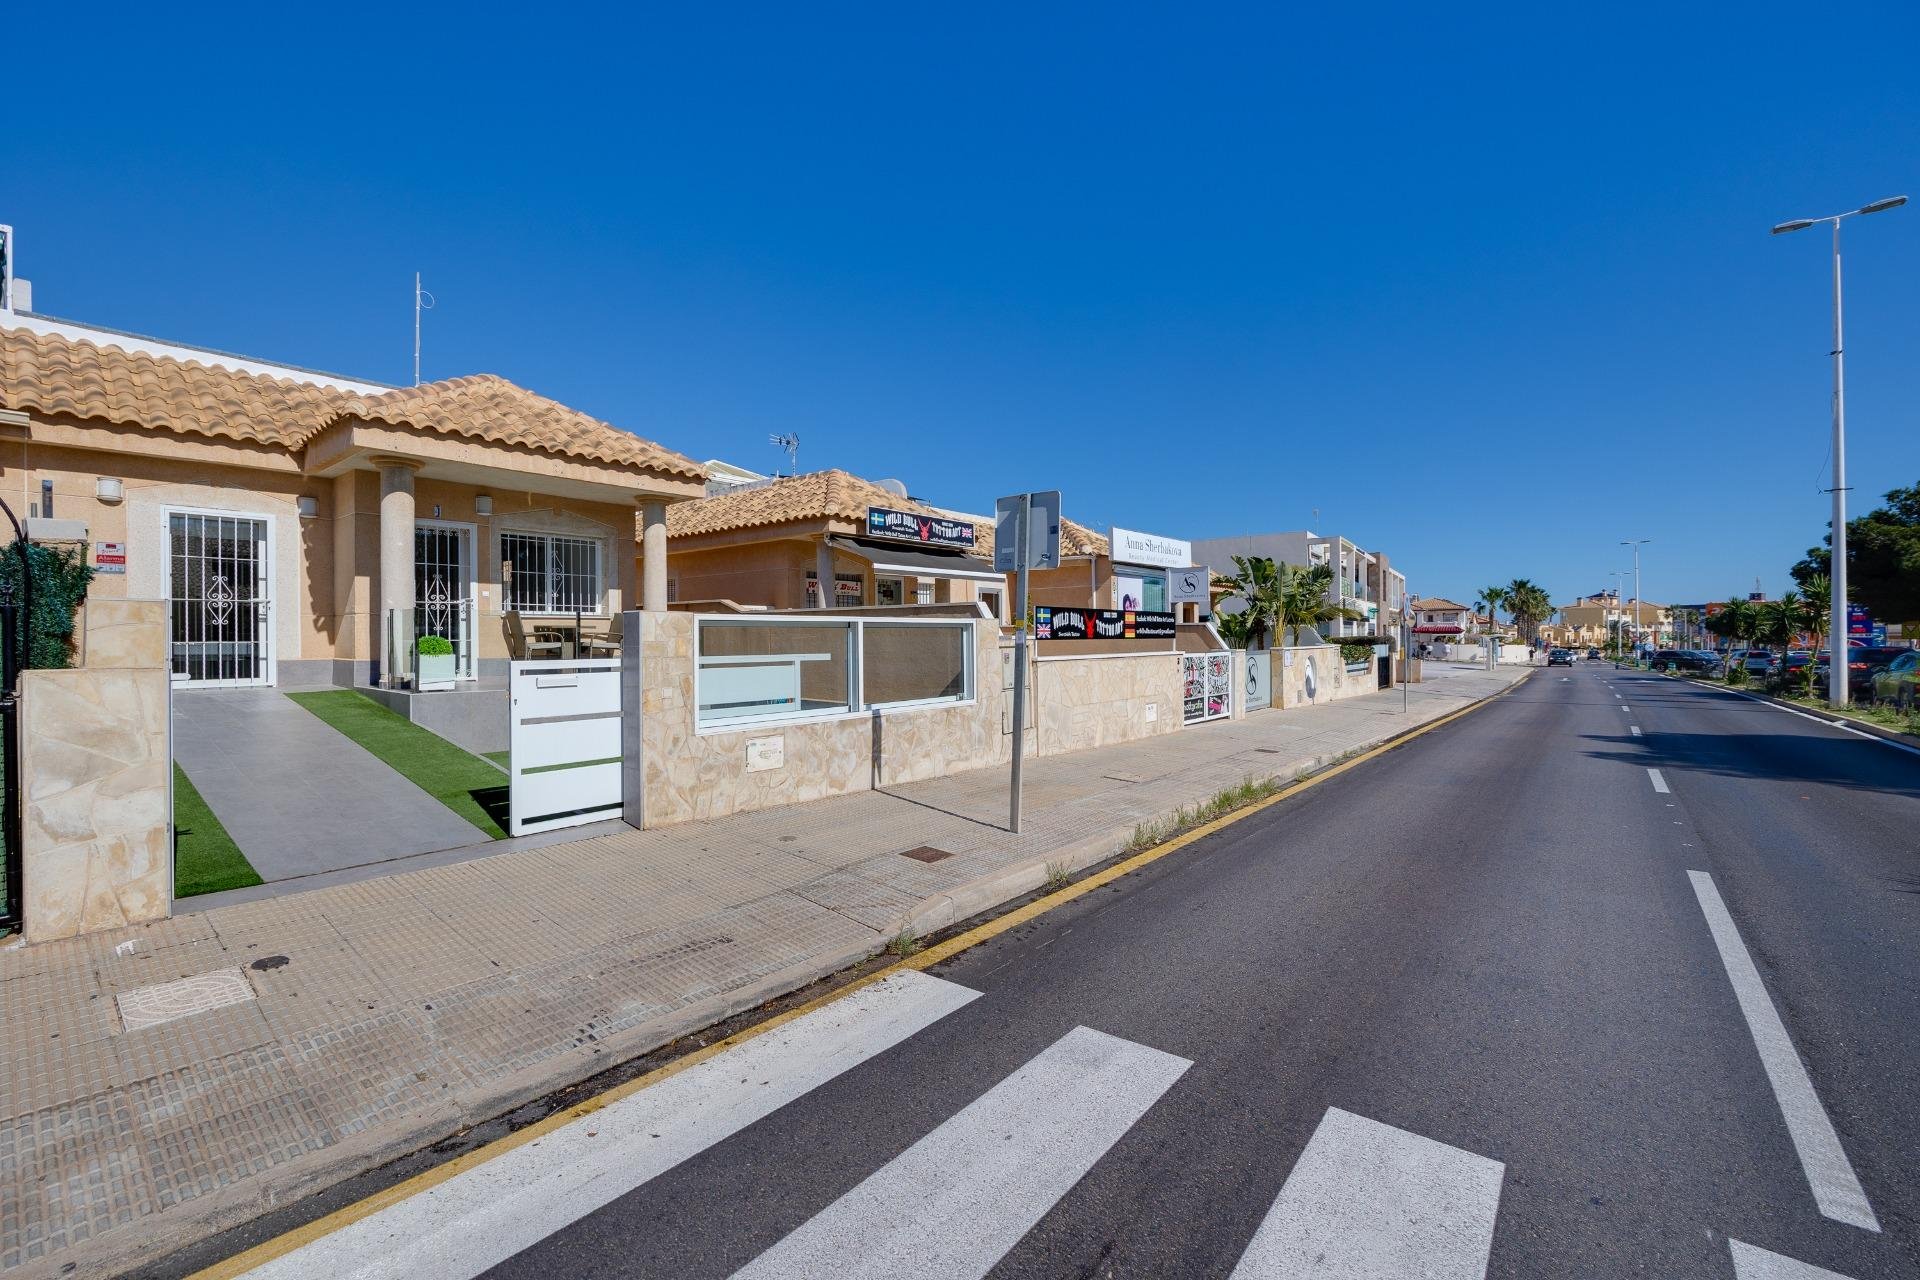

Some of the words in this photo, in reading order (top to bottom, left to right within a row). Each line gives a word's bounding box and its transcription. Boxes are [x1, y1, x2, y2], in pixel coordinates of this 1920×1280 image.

[885, 513, 902, 526] WILD
[903, 514, 919, 530] BULL
[1125, 536, 1143, 550] Anna
[1144, 539, 1182, 556] Sherbakova
[1053, 611, 1069, 630] WILD
[1070, 611, 1085, 630] BULL
